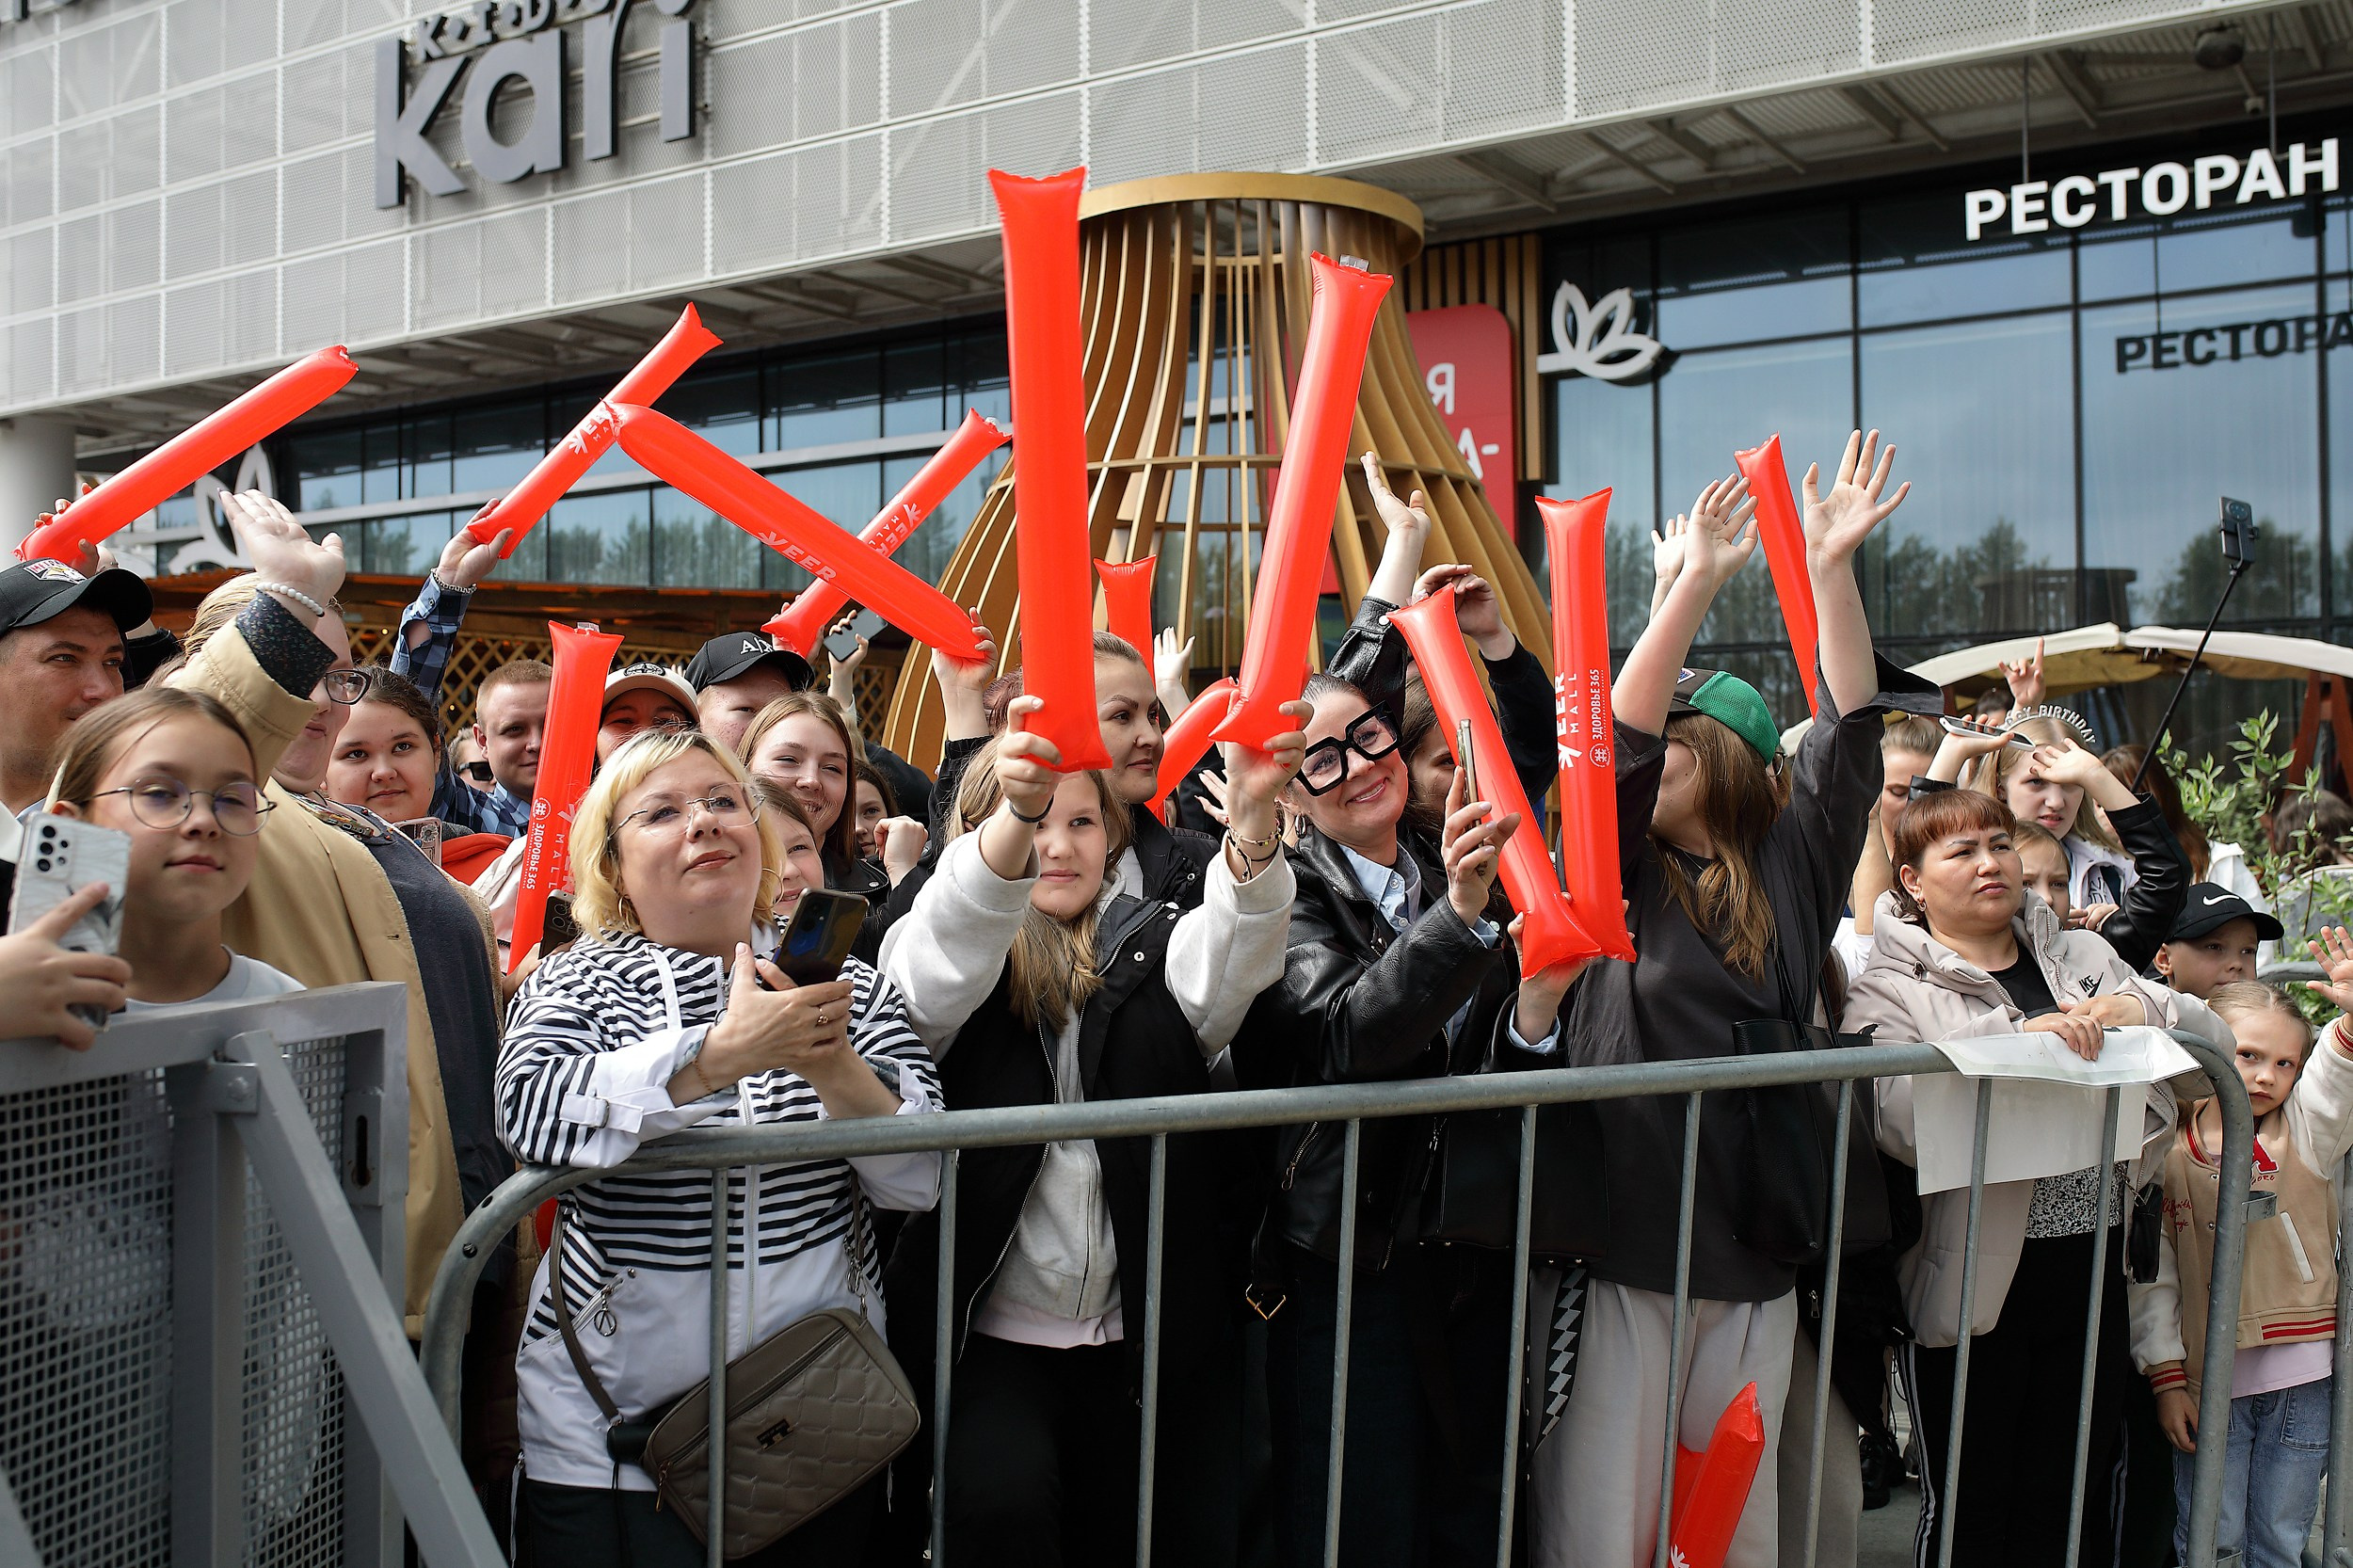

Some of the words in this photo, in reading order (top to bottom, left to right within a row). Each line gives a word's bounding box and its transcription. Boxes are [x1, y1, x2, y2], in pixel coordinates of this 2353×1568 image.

[376, 0, 695, 209] kari
[1965, 137, 2340, 241] РЕСТОРАН
[1568, 673, 1579, 733] MALL
[2038, 704, 2096, 744] BIRTHDAY
[548, 834, 566, 888] MALL
